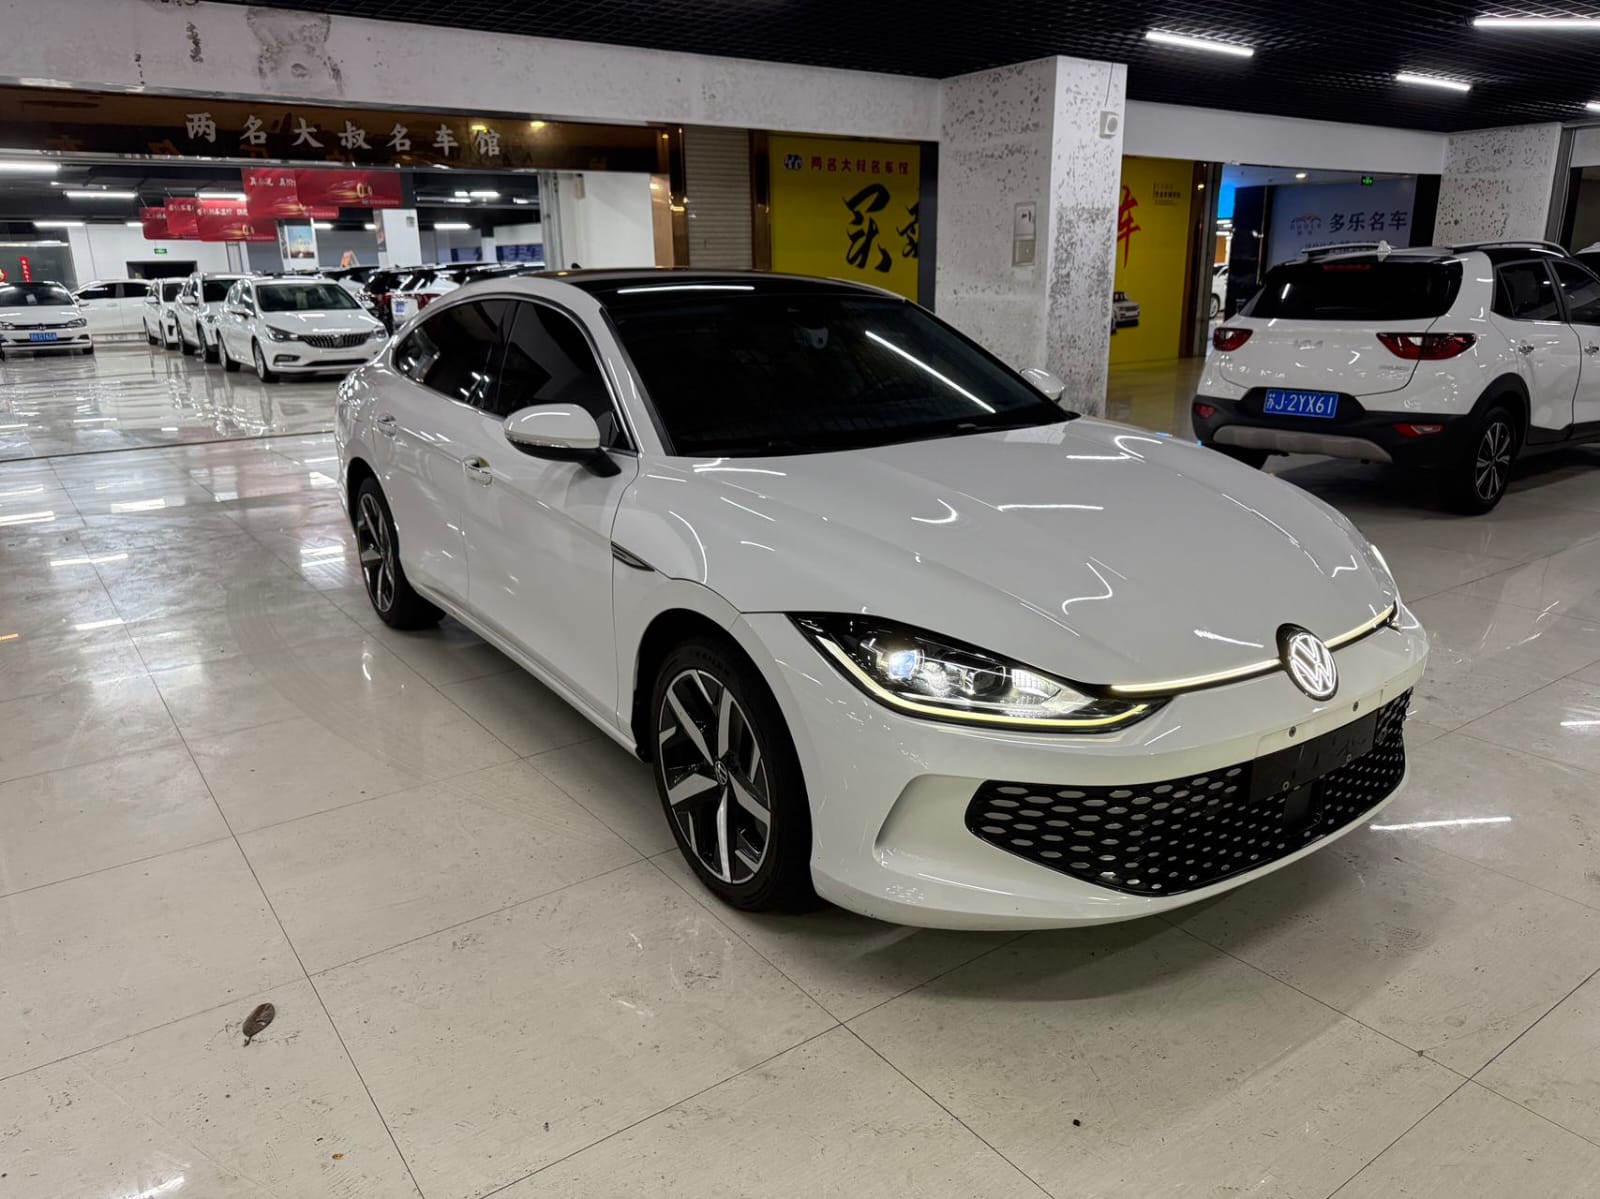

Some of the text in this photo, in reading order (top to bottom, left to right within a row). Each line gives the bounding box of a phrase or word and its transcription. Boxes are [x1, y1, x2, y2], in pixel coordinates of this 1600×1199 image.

[186, 112, 501, 157] 两名大叔名车馆
[1328, 210, 1409, 233] 多乐名车
